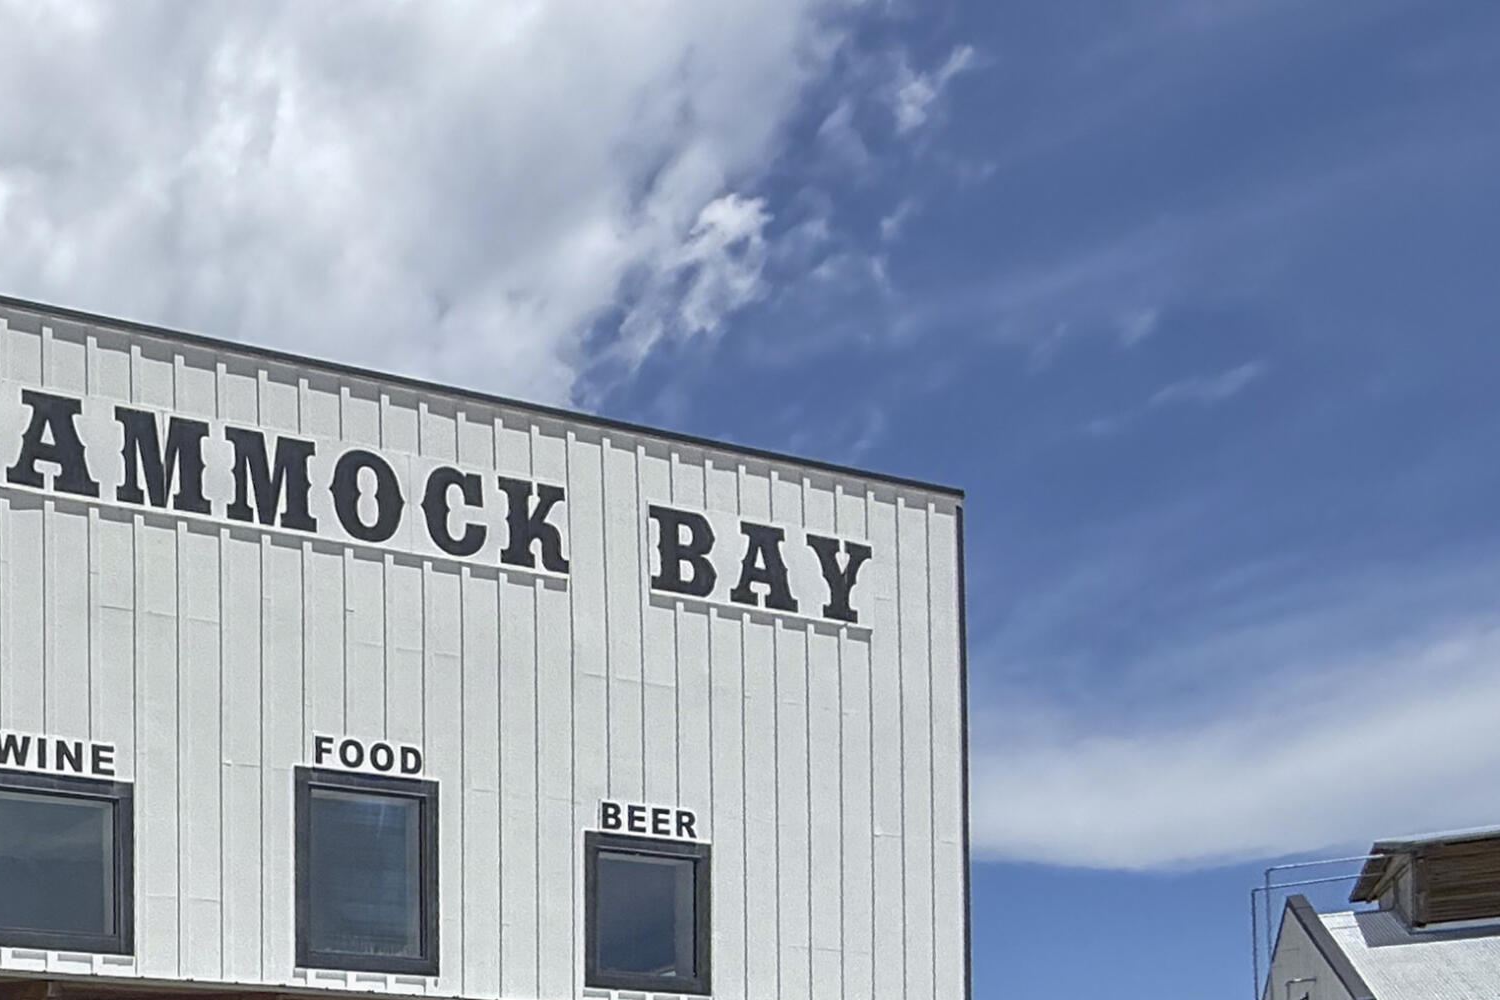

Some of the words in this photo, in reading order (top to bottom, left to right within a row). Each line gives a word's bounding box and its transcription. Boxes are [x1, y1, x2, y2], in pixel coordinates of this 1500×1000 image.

[648, 504, 872, 624] BAY
[314, 736, 423, 776] FOOD
[602, 802, 697, 839] BEER
